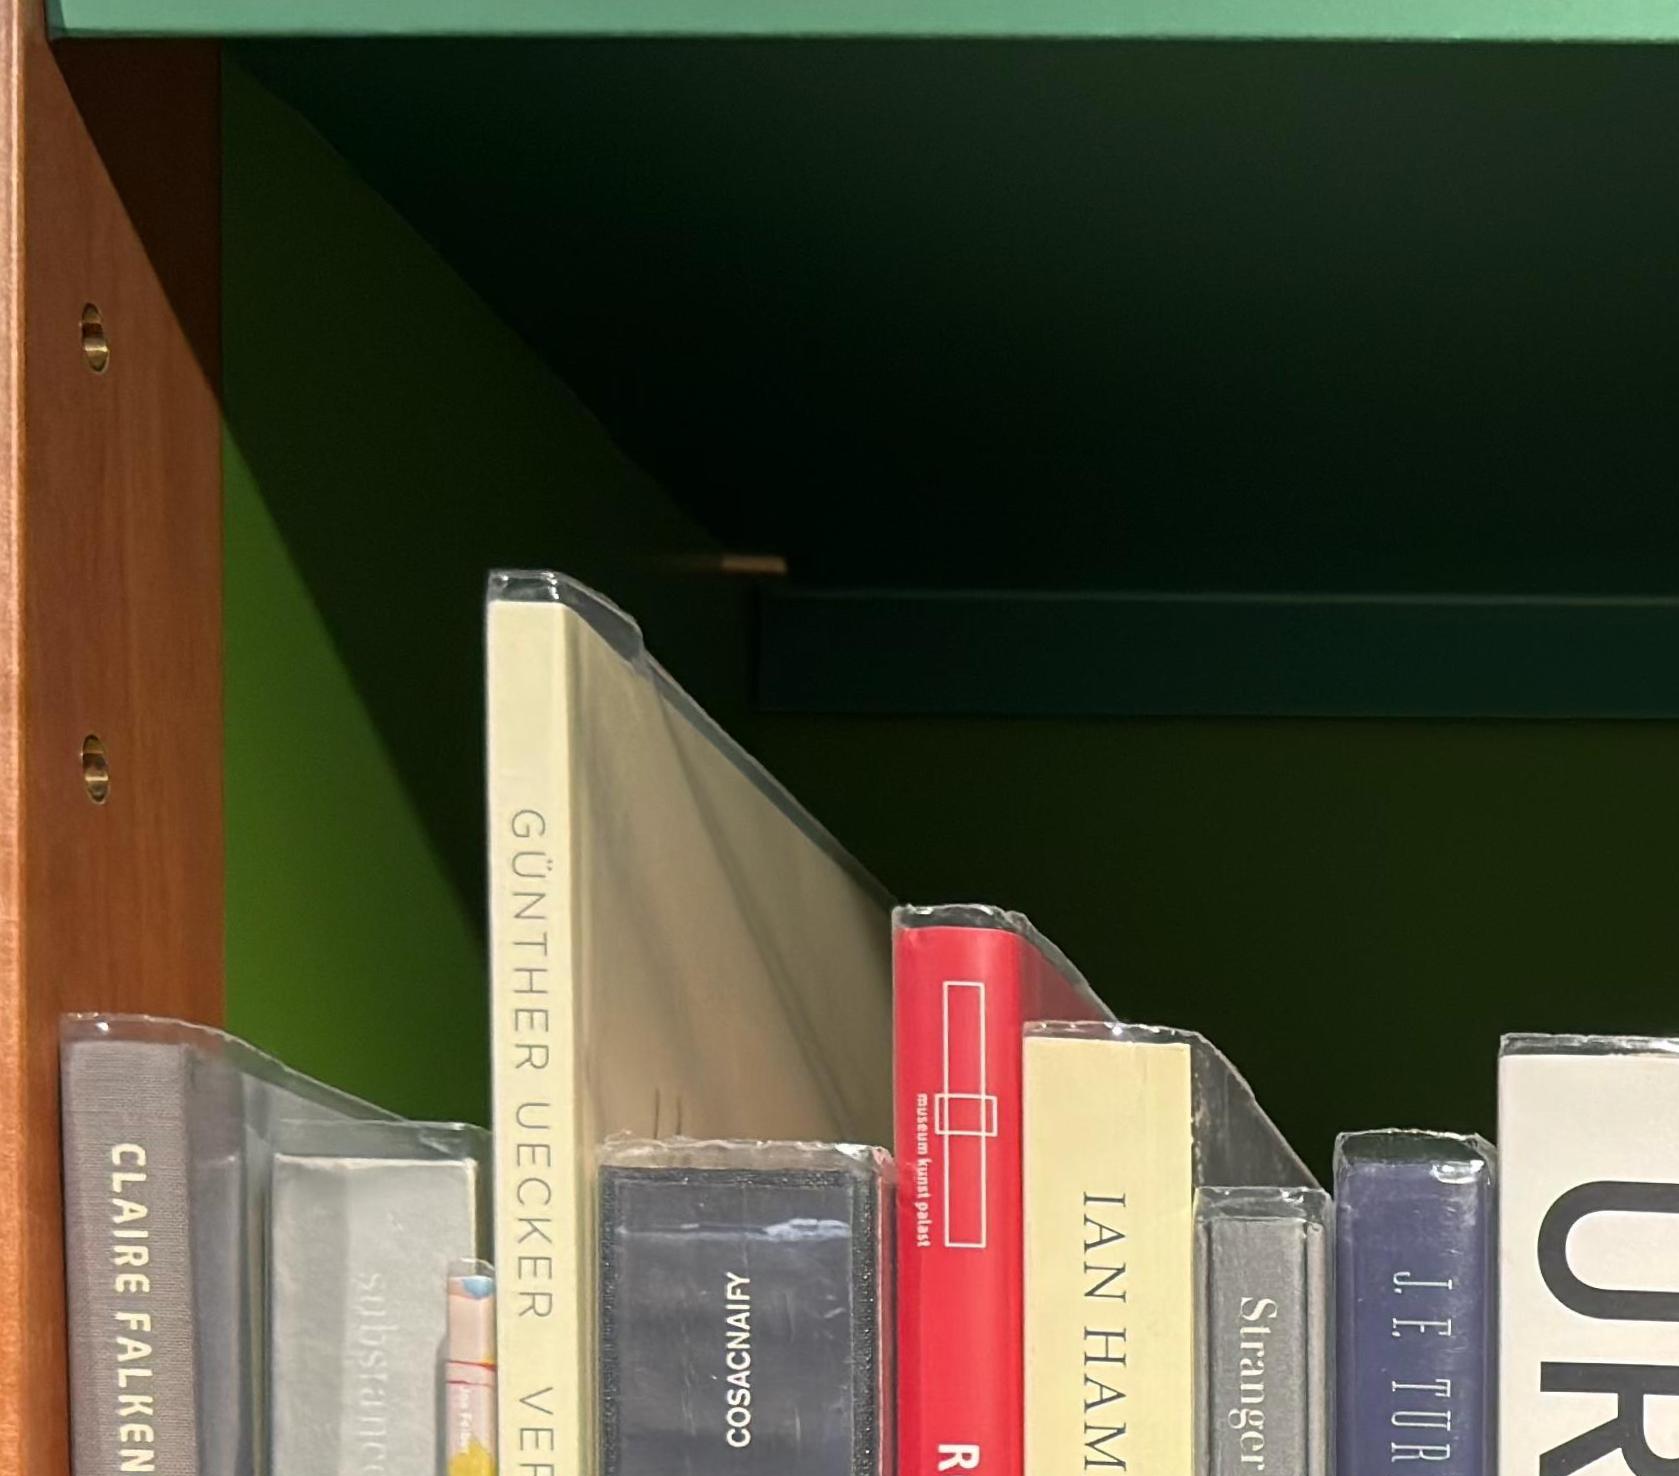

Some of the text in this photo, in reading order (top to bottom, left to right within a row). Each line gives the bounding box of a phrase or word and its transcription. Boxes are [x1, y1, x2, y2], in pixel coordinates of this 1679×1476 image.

[511, 810, 552, 1317] GÜNTHER UECKER
[111, 1144, 149, 1292] CLAIRE
[915, 1094, 932, 1247] museum kunst palast
[1084, 1192, 1126, 1302] IAN
[726, 1272, 751, 1447] COSACNAIFY
[1229, 1296, 1278, 1472] Stranger
